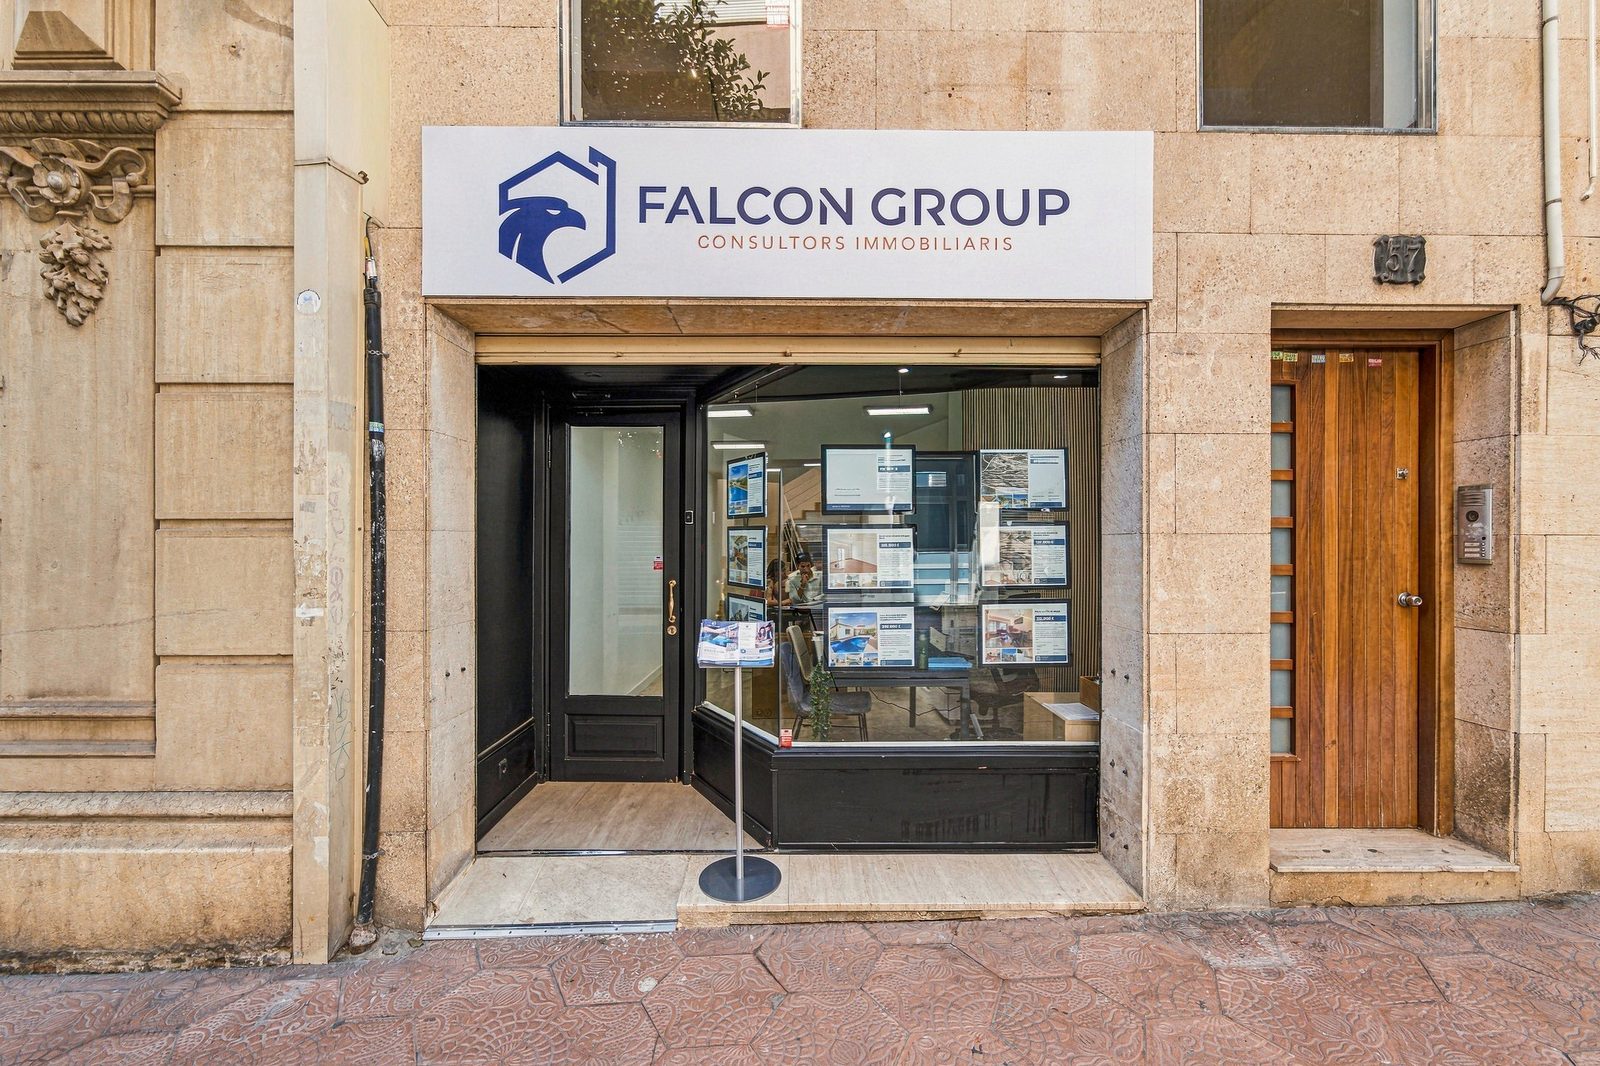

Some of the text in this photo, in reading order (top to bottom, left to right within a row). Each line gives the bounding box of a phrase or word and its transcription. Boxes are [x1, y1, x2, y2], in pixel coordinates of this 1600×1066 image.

[638, 185, 1070, 227] FALCON GROUP
[698, 235, 1013, 251] CONSULTORS IMMOBILIARIS
[1386, 240, 1421, 274] 57
